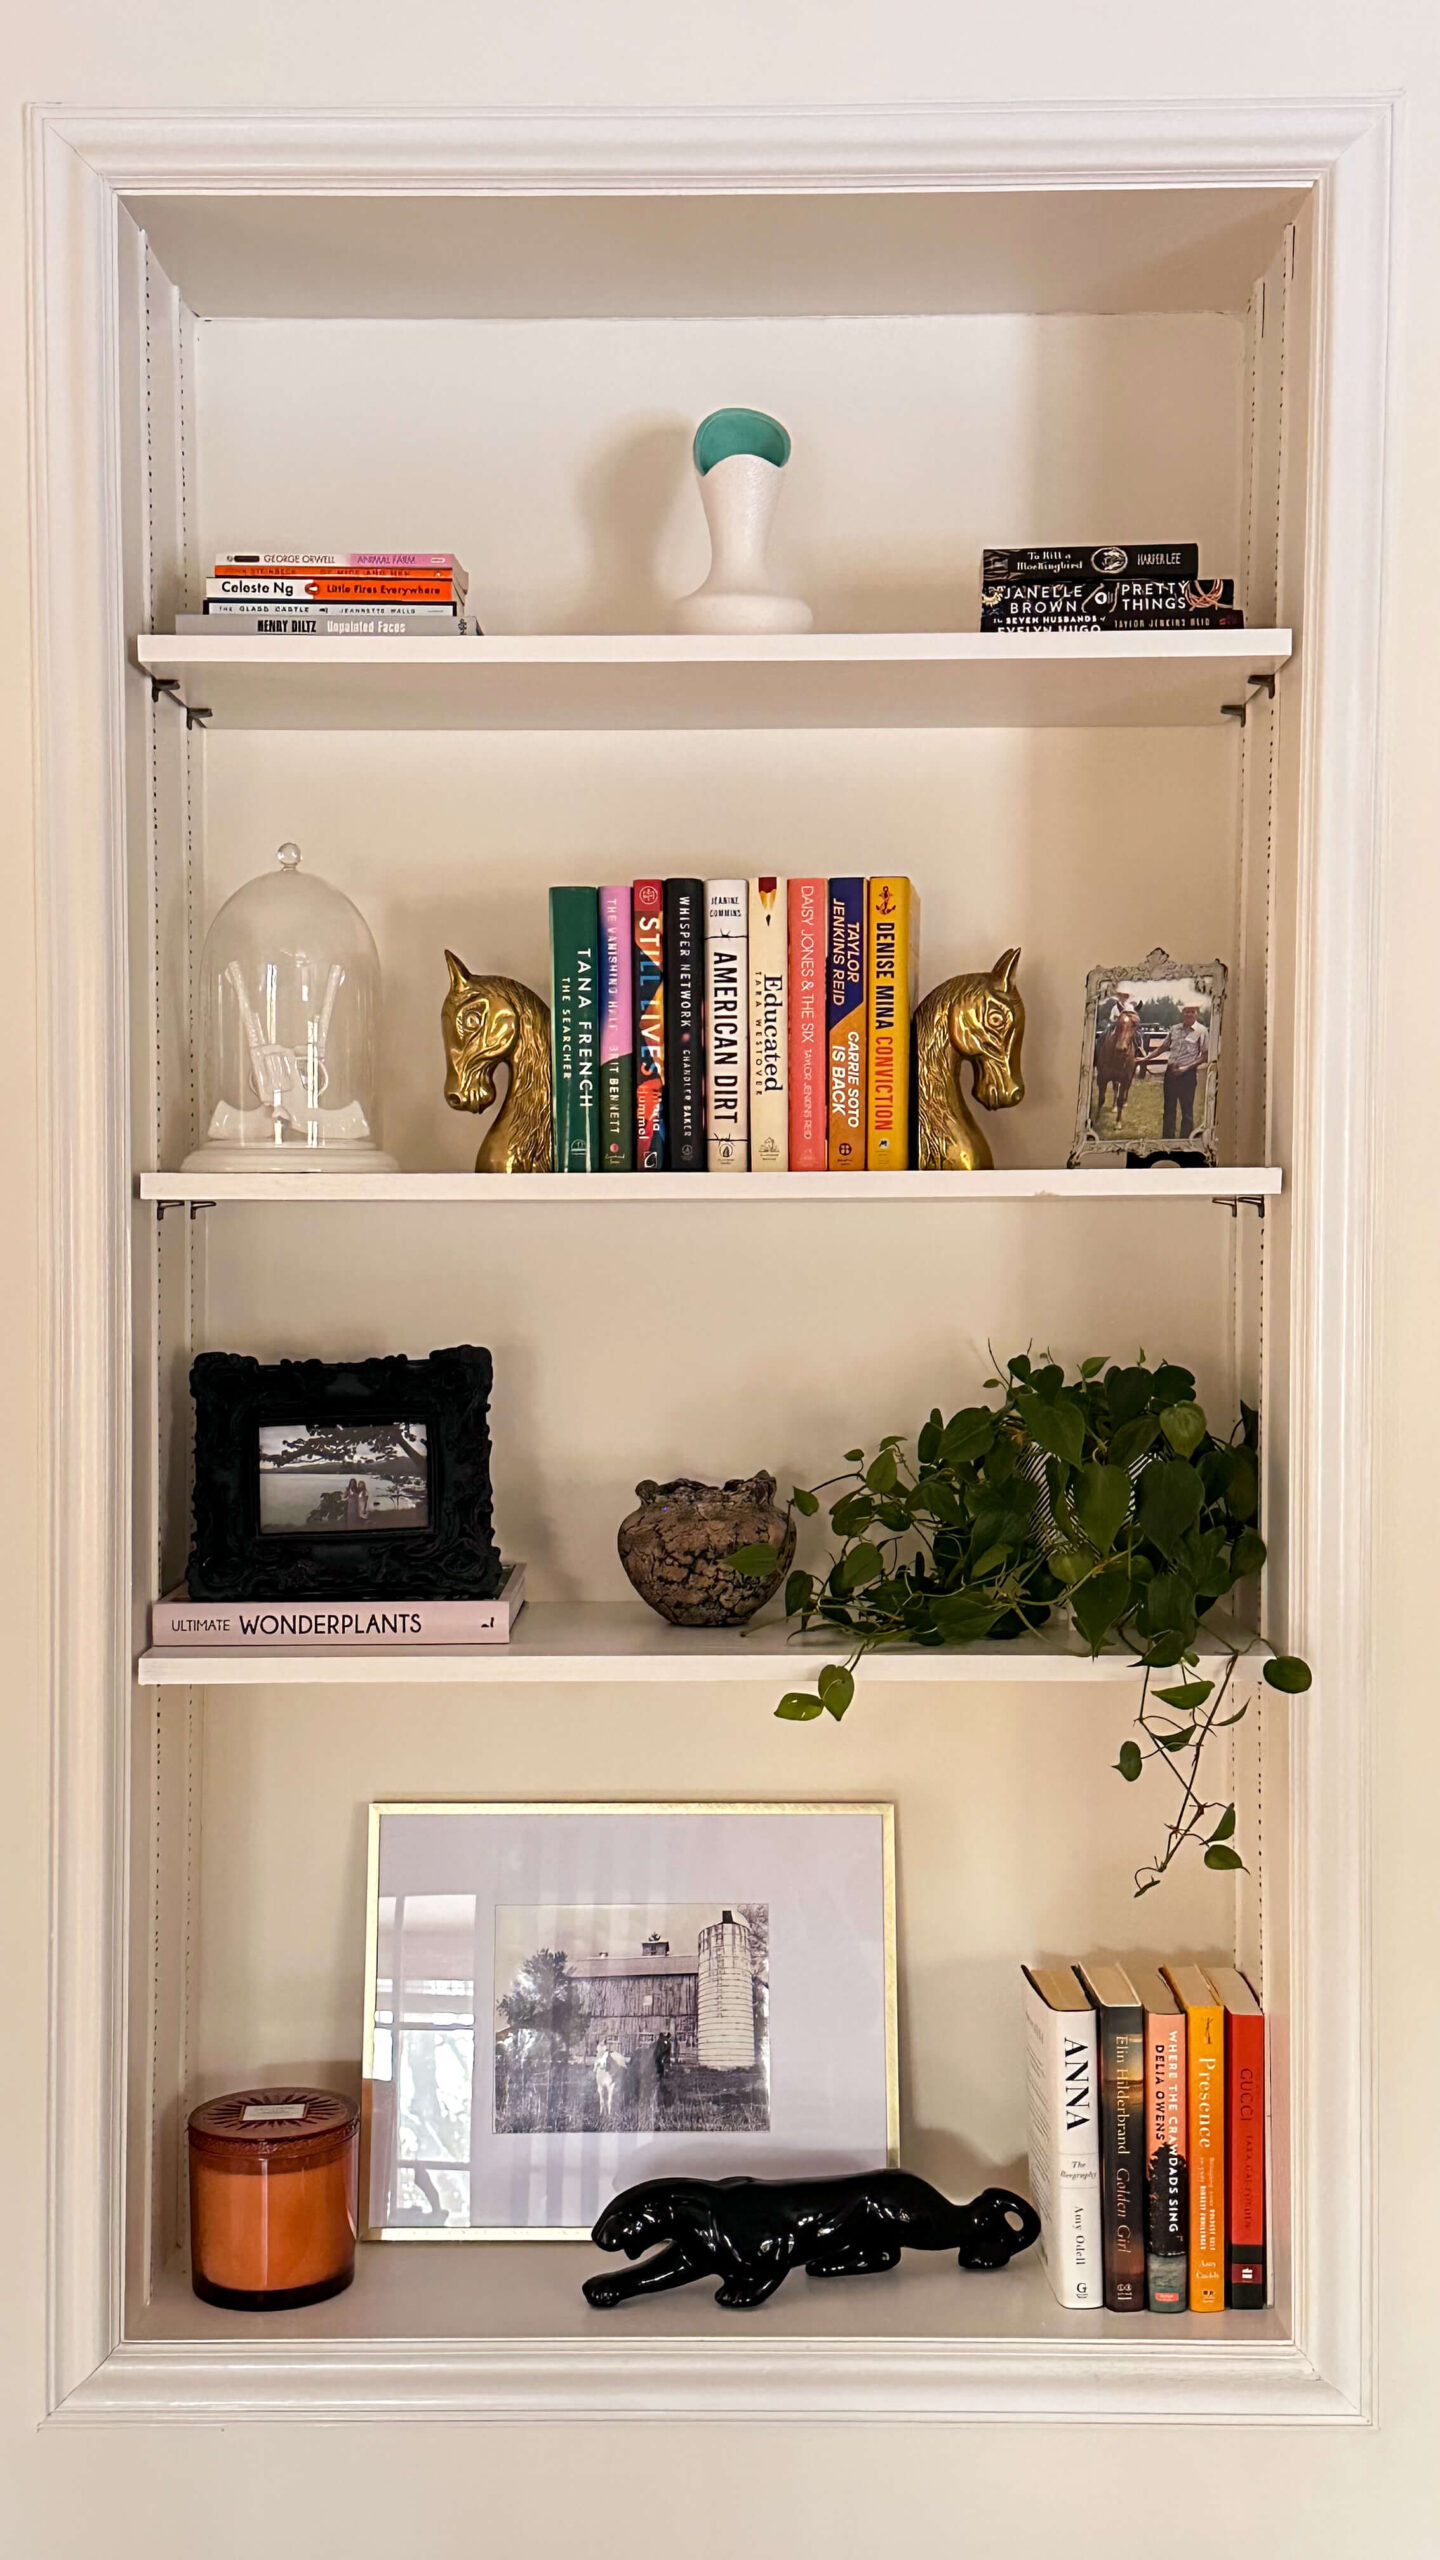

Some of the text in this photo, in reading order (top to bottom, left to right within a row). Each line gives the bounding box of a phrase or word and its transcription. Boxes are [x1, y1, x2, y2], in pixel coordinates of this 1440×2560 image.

[264, 554, 336, 564] GEORGE ORWELL
[357, 555, 416, 564] ANIMAL FARM
[1017, 561, 1083, 573] Mockingbird
[1027, 551, 1040, 560] To
[1043, 551, 1062, 560] Kill
[1137, 553, 1182, 566] HARPER LEE
[222, 580, 294, 596] Celeste Ng
[327, 584, 441, 596] Little Fires Everywhere
[1004, 586, 1083, 600] JANELLE
[1010, 601, 1077, 614] BROWN
[1121, 580, 1190, 596] PRETTY
[1122, 598, 1186, 611] THINGS
[257, 620, 316, 633] HENRY DILTZ
[378, 621, 406, 633] Faces
[1114, 619, 1145, 628] TAYLOR
[1148, 618, 1186, 628] JENKINS
[1190, 618, 1210, 626] REID
[711, 896, 739, 905] JEANINE
[607, 898, 619, 1032] THE VANISHING HALF
[679, 896, 692, 1028] WHISPER NETWORK
[800, 886, 814, 1043] DAISY JONES & THE SIX
[832, 898, 845, 1007] JENKINS REID
[846, 922, 860, 984] TAYLOR
[876, 922, 895, 1030] DENISE MINA
[639, 916, 662, 1077] STILL LIVES
[561, 977, 572, 1080] THE SEARCHER
[576, 948, 594, 1108] TANA FRENCH
[714, 952, 738, 1124] AMERICAN DIRT
[764, 974, 784, 1092] Educated
[609, 1078, 620, 1134] BENNETT
[682, 1050, 692, 1137] CHANDLER BAKER
[803, 1049, 812, 1140] TAYLOR JENKINS REID
[832, 1045, 846, 1116] IS BACK
[848, 1032, 860, 1128] CARRIE SOTO
[874, 1036, 894, 1131] CONVICTION
[638, 1085, 650, 1140] Hummel
[172, 1614, 422, 1636] ULTIMATE WONDERPLANTS
[1064, 2037, 1090, 2130] ANNA
[1116, 2036, 1130, 2154] Elin Hilderbrand
[1155, 2044, 1165, 2141] DELIA OWENS
[1199, 2058, 1216, 2148] Presence
[1240, 2068, 1254, 2120] GUCCI
[1168, 2030, 1178, 2232] WHERE THE CRAWDADS SING
[1073, 2206, 1086, 2265] Amy Odell
[1116, 2168, 1132, 2253] Golden Girl
[1076, 2282, 1087, 2294] G
